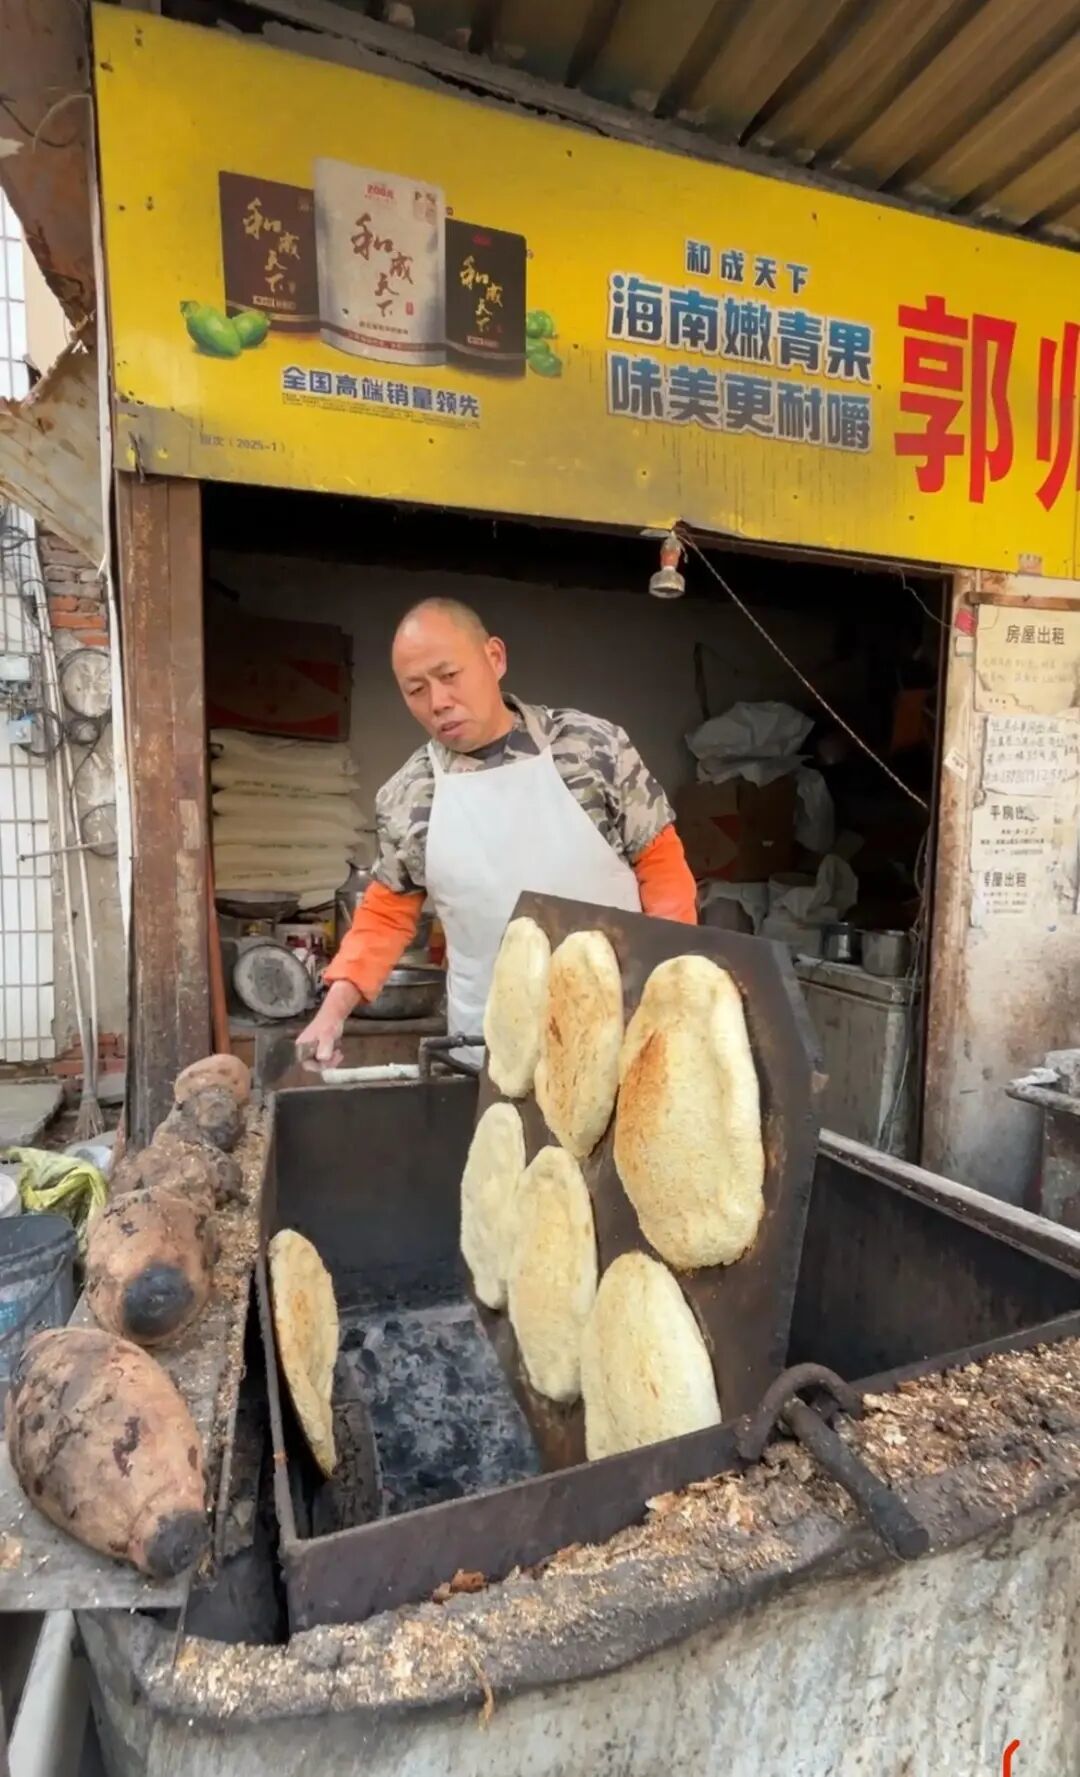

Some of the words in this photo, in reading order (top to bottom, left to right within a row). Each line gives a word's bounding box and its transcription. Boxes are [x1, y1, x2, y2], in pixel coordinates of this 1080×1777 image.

[685, 239, 809, 294] 和成天下
[610, 273, 872, 381] 海南嫩青果
[282, 365, 480, 419] 全国高端销量领先
[608, 353, 872, 451] 味美更耐嚼
[1006, 624, 1064, 645] 房屋出租
[990, 805, 1032, 821] 平房出
